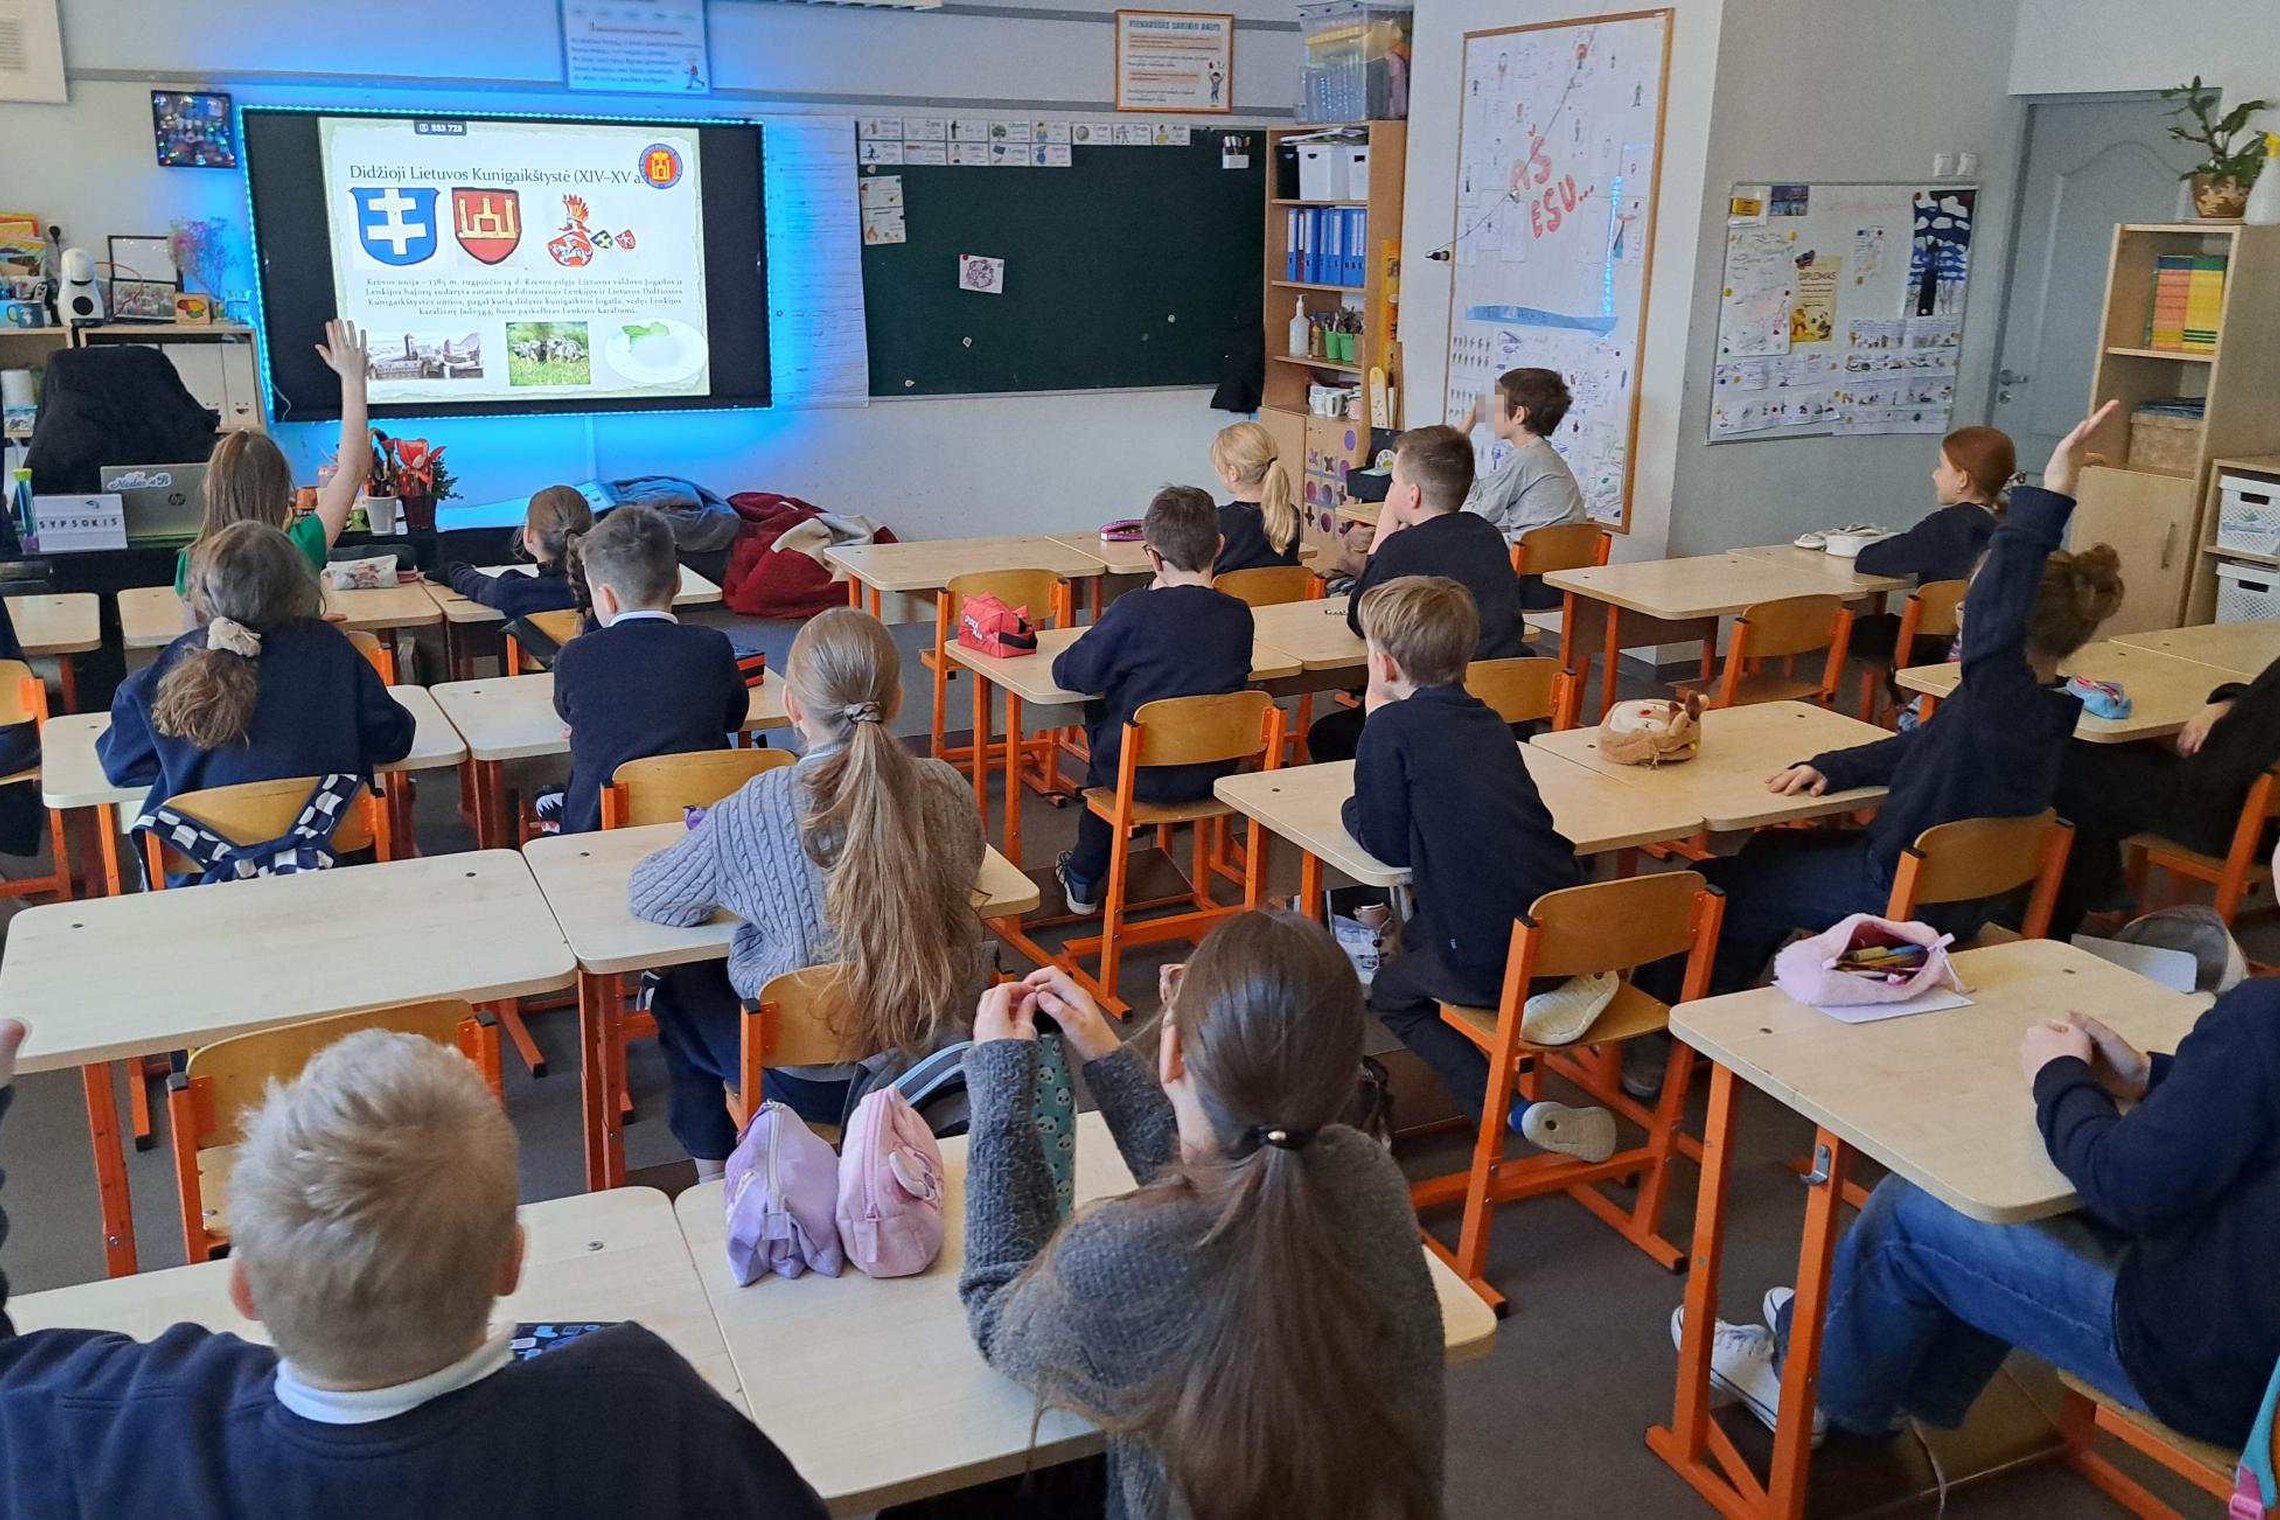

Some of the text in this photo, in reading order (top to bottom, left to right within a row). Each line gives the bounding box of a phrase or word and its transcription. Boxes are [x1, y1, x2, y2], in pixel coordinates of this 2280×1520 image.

[350, 164, 406, 183] Didžioji
[410, 166, 469, 180] Lietuvos
[472, 167, 571, 185] Kunigaikštystė
